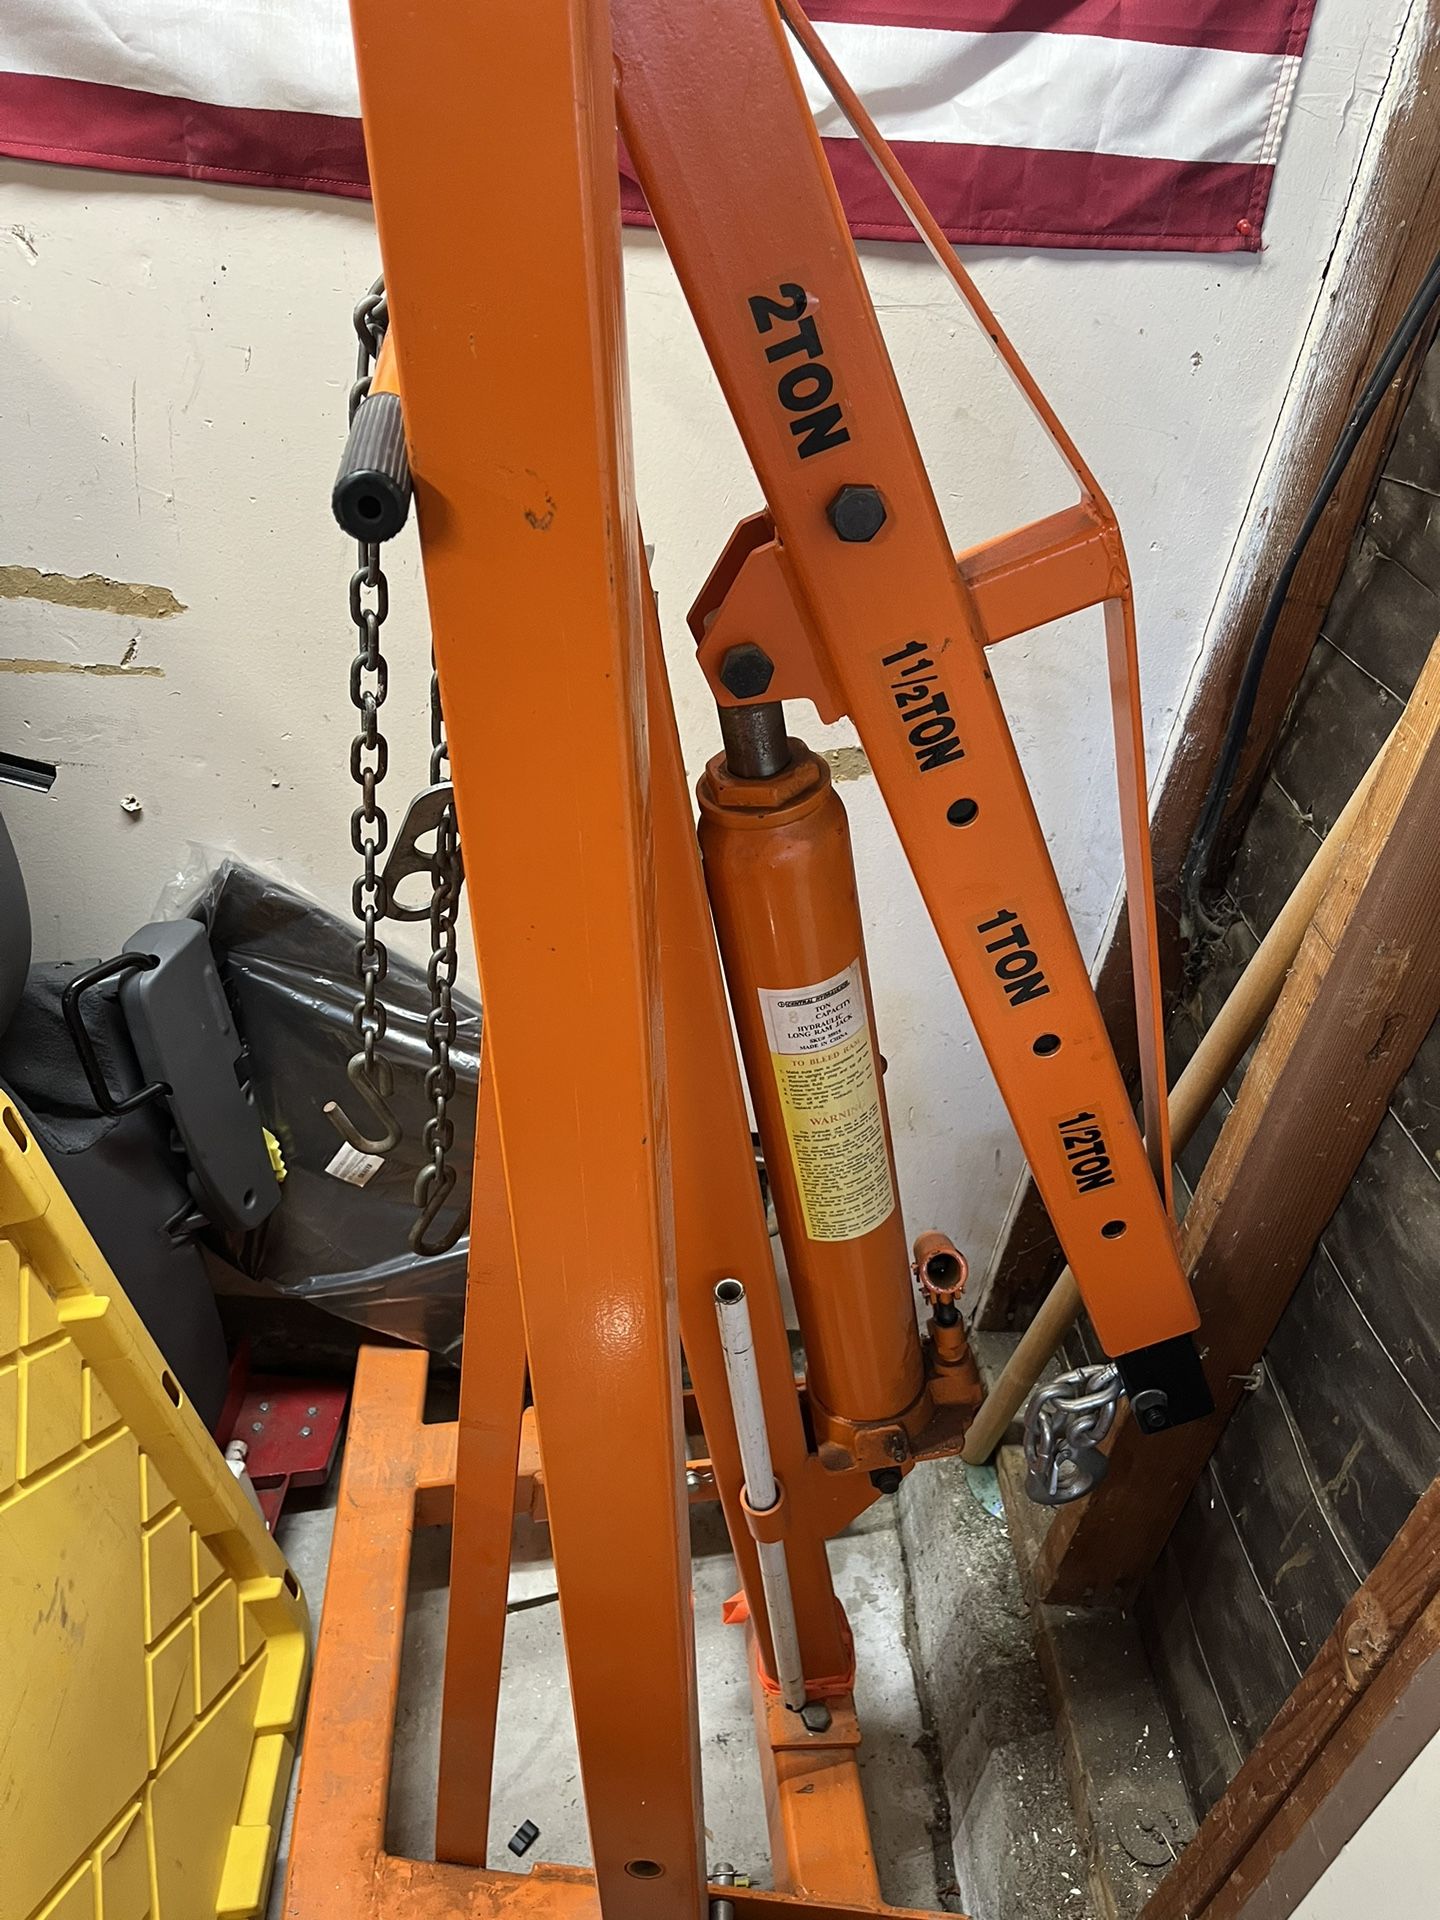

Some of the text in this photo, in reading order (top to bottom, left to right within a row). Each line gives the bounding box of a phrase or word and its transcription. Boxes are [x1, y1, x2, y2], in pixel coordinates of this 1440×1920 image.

[815, 1002, 831, 1013] TON
[815, 998, 851, 1020] CAPACITY
[787, 1031, 811, 1040] LONG
[814, 1024, 833, 1036] RAM
[835, 1014, 853, 1029] JACK
[797, 1013, 844, 1033] HYDRAULIC
[799, 1043, 819, 1051] MADE
[829, 1031, 848, 1044] CHINA
[809, 1051, 840, 1066] BLEED
